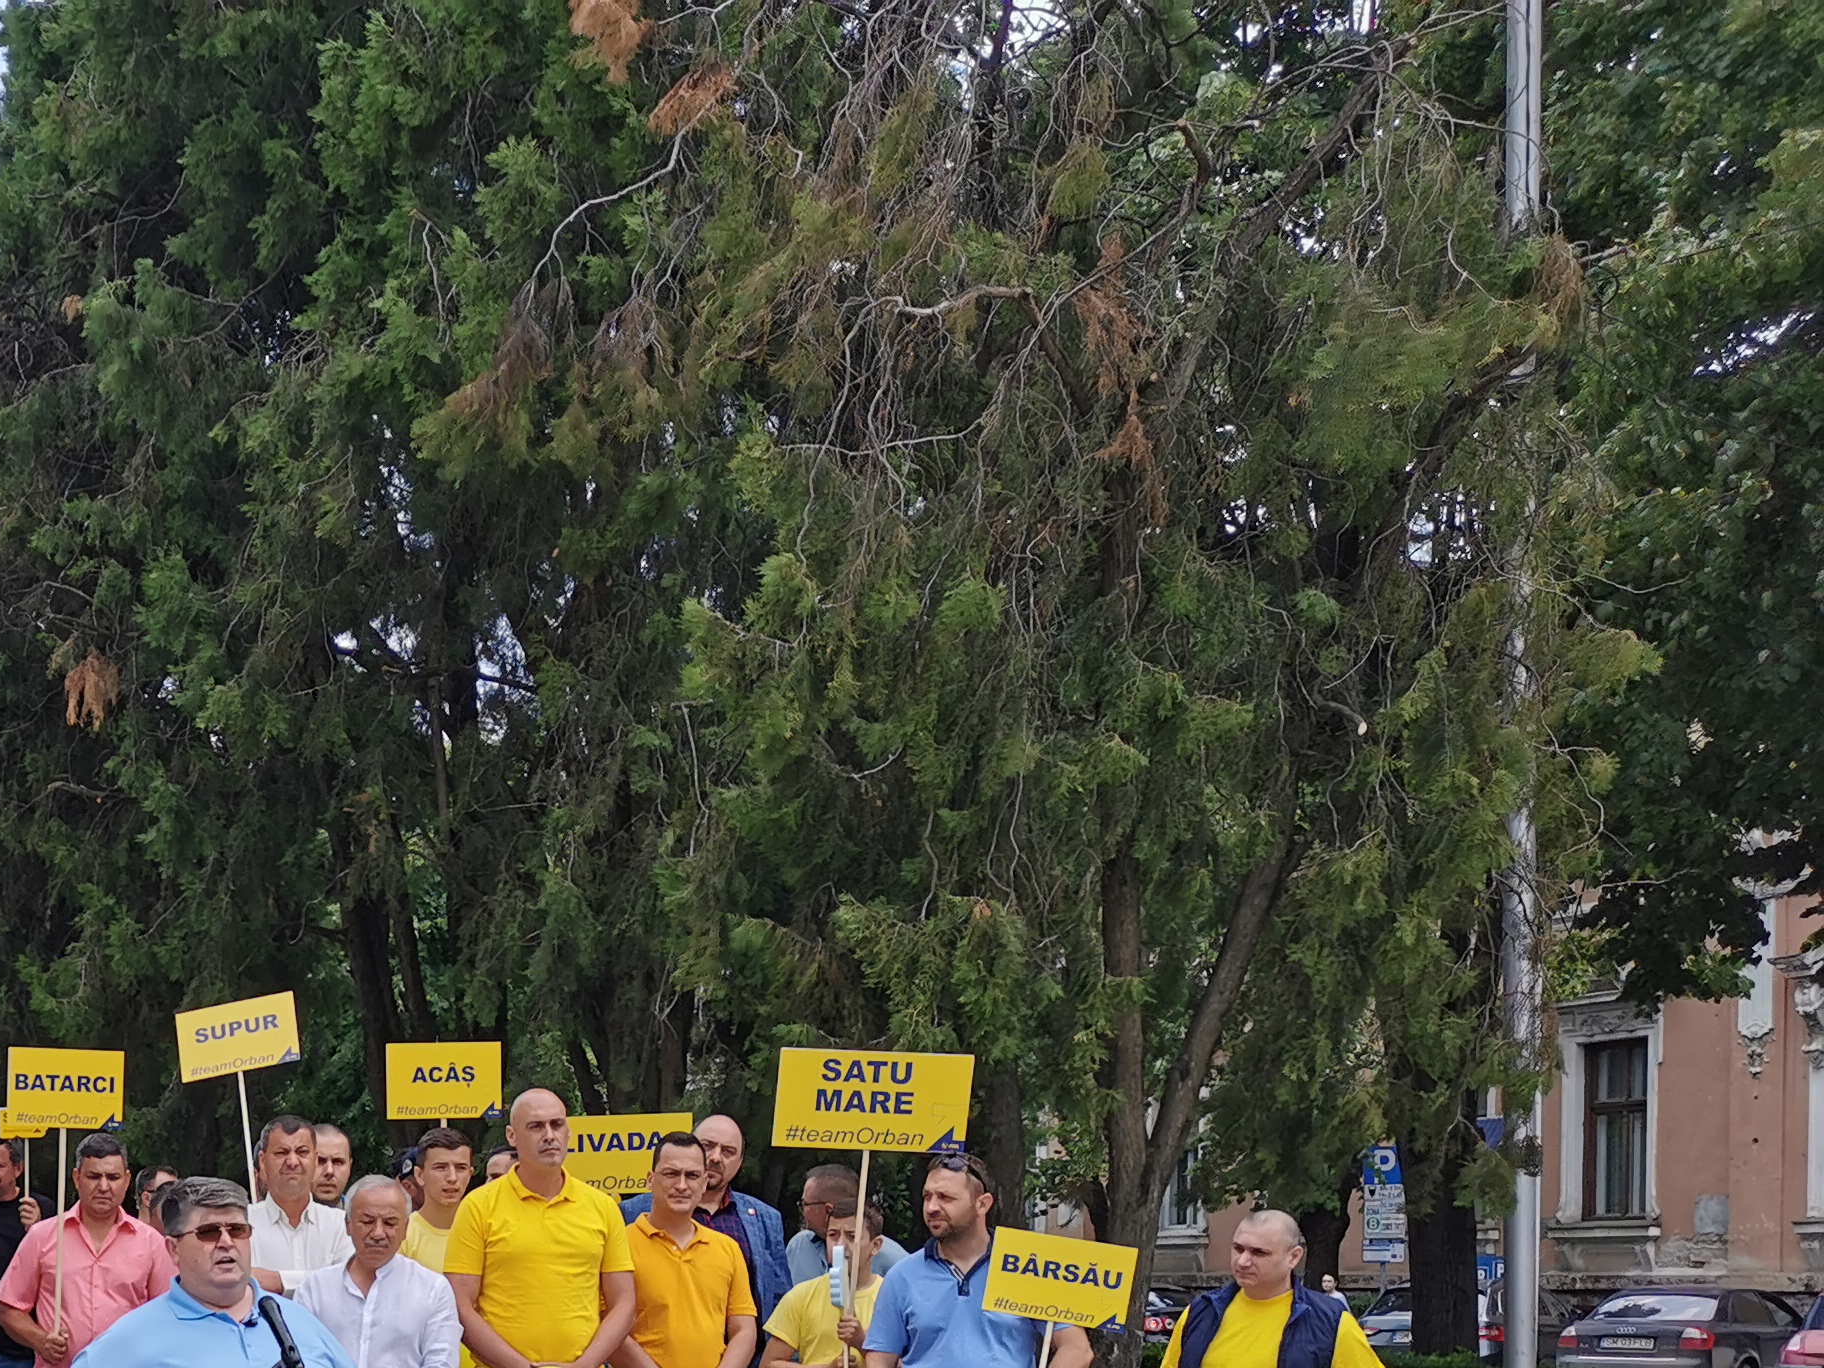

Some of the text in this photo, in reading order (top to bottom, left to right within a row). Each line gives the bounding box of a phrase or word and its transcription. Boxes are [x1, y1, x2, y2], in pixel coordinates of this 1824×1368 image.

[195, 1014, 279, 1043] SUPUR
[190, 1053, 275, 1077] #teamOrban
[411, 1062, 476, 1088] ACÂȘ
[821, 1058, 913, 1085] SATU
[14, 1073, 115, 1094] BATARCI
[396, 1103, 479, 1116] #teamOrban
[815, 1089, 915, 1115] MARE
[16, 1112, 99, 1126] #teamOrban
[785, 1124, 925, 1146] #teamOrban
[1001, 1253, 1123, 1290] BÂRSĂU
[993, 1297, 1096, 1324] #teamOrban
